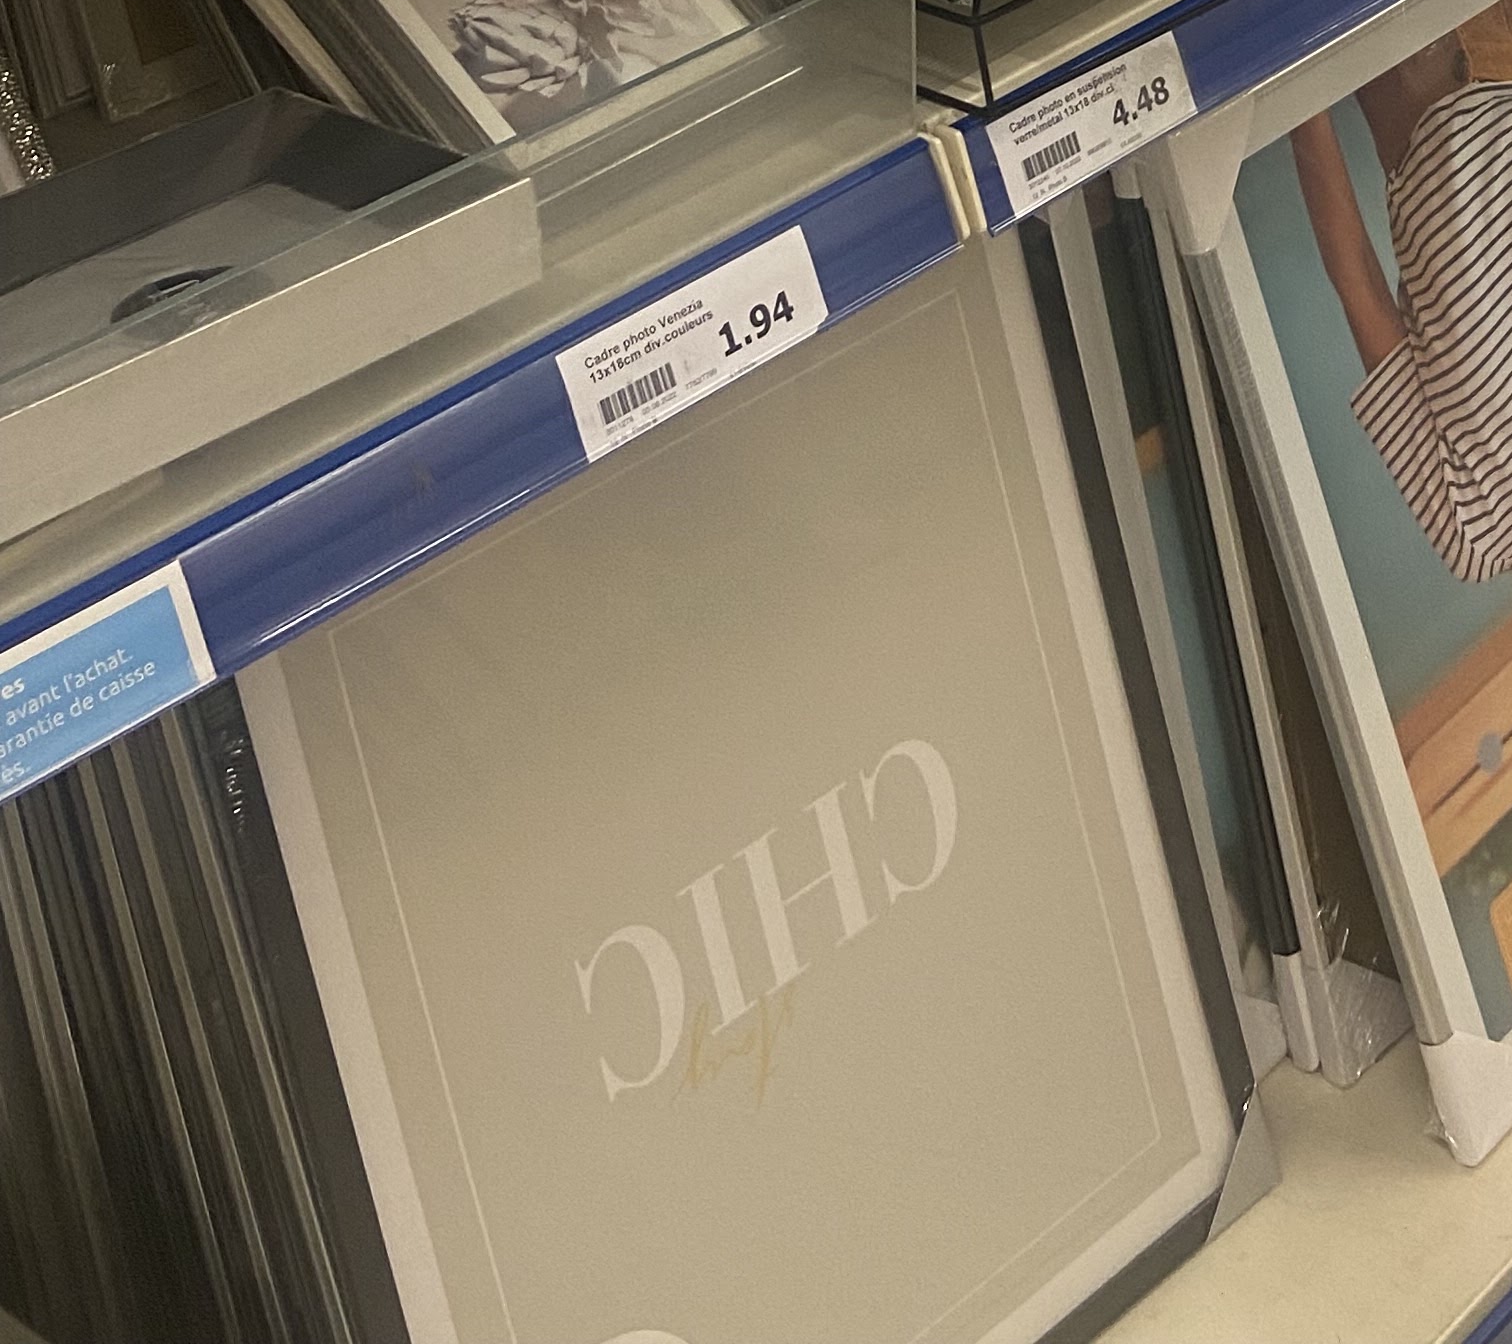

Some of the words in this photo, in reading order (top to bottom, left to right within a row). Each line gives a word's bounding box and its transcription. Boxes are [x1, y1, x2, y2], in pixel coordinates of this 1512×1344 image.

[1009, 114, 1037, 133] Cadre
[1038, 100, 1063, 120] photo
[1065, 92, 1076, 103] en
[1078, 63, 1127, 96] suspension
[1014, 112, 1064, 146] verre/métal
[1113, 76, 1170, 127] 4.48
[584, 342, 621, 370] Cadre
[622, 323, 657, 354] photo
[657, 297, 704, 329] Venezia
[588, 350, 642, 385] 13x18cm
[643, 308, 714, 356] div.couleurs
[718, 290, 794, 358] 1.94
[6, 684, 61, 727] avant
[63, 648, 134, 693] l'achat.
[69, 693, 94, 718] de
[98, 661, 157, 702] caisse
[574, 738, 959, 1103] CHIC
